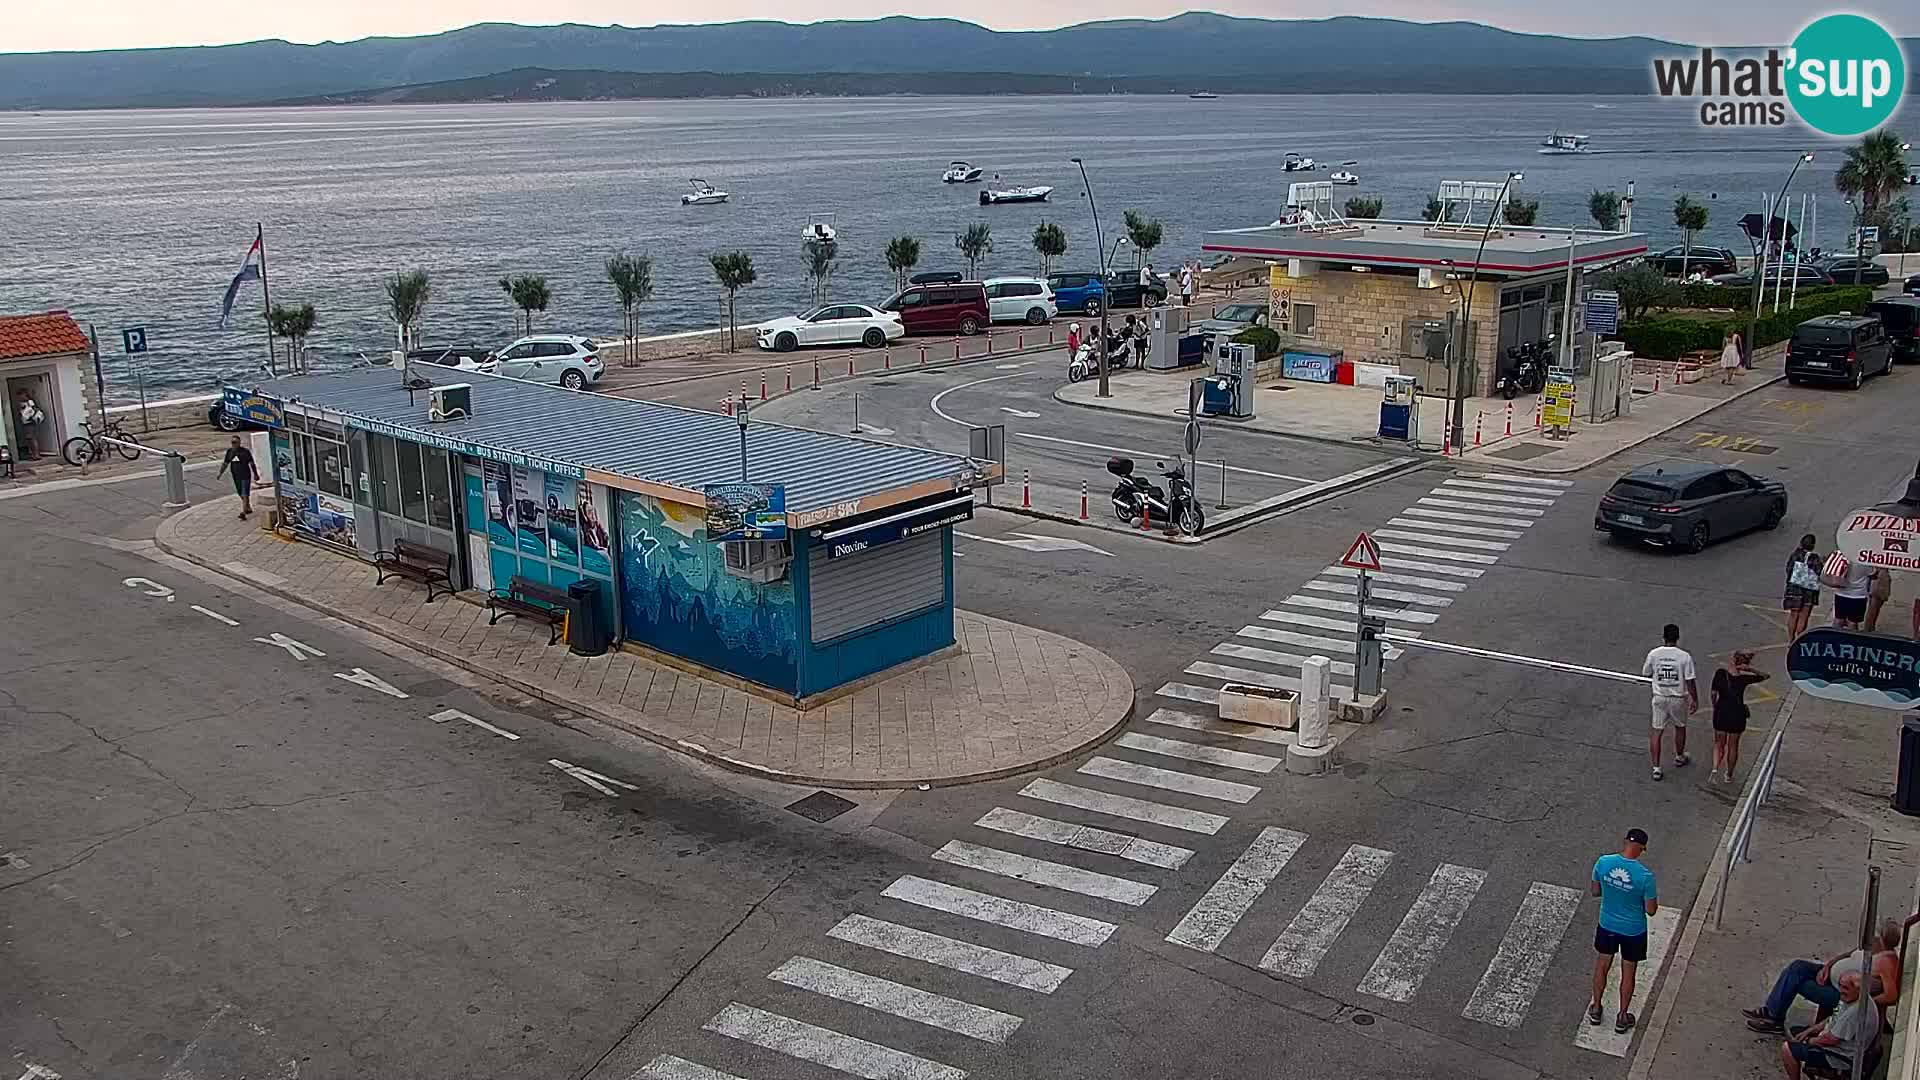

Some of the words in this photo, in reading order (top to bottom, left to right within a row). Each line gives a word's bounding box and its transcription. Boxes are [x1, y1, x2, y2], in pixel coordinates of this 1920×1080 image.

[128, 331, 141, 350] P
[1685, 432, 1763, 451] TAXI
[436, 437, 467, 453] POSTAJA
[477, 446, 492, 458] BUS
[493, 449, 525, 465] STATION
[528, 457, 553, 472] TICKET
[554, 463, 581, 478] OFFICE
[838, 500, 861, 517] SKY
[1880, 530, 1916, 540] GRILL
[1828, 662, 1864, 676] caffe
[1868, 665, 1896, 680] bar
